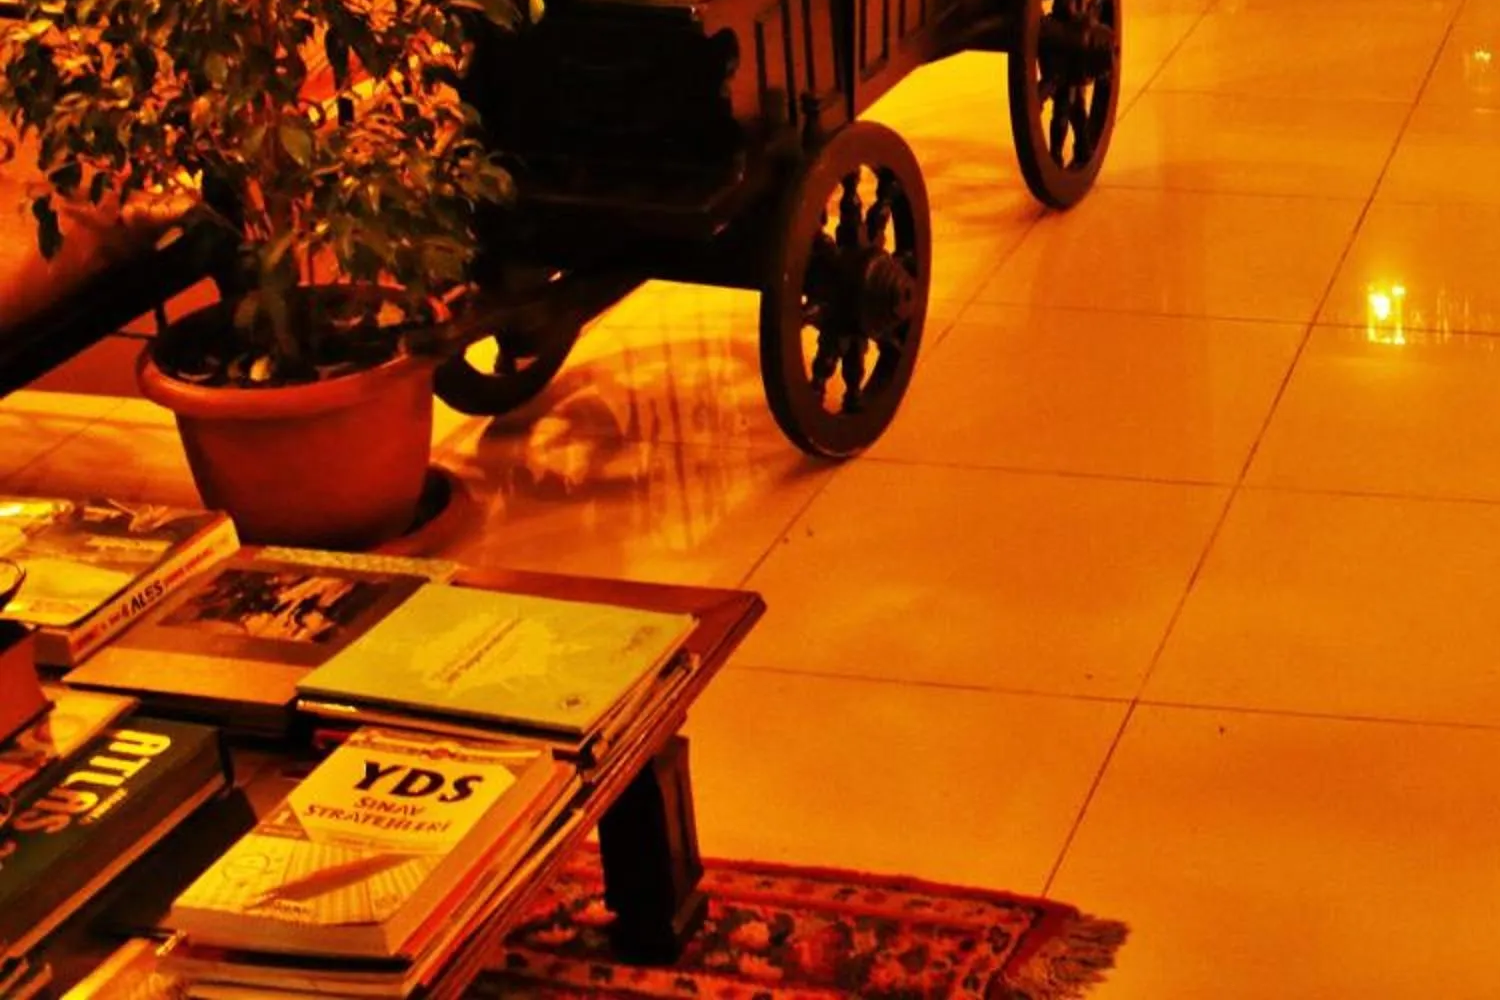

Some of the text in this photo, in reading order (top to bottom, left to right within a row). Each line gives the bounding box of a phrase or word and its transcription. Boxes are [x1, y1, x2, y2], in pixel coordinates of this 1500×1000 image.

[129, 569, 165, 617] ALES
[13, 729, 171, 834] ATLAS
[353, 759, 484, 803] YDS
